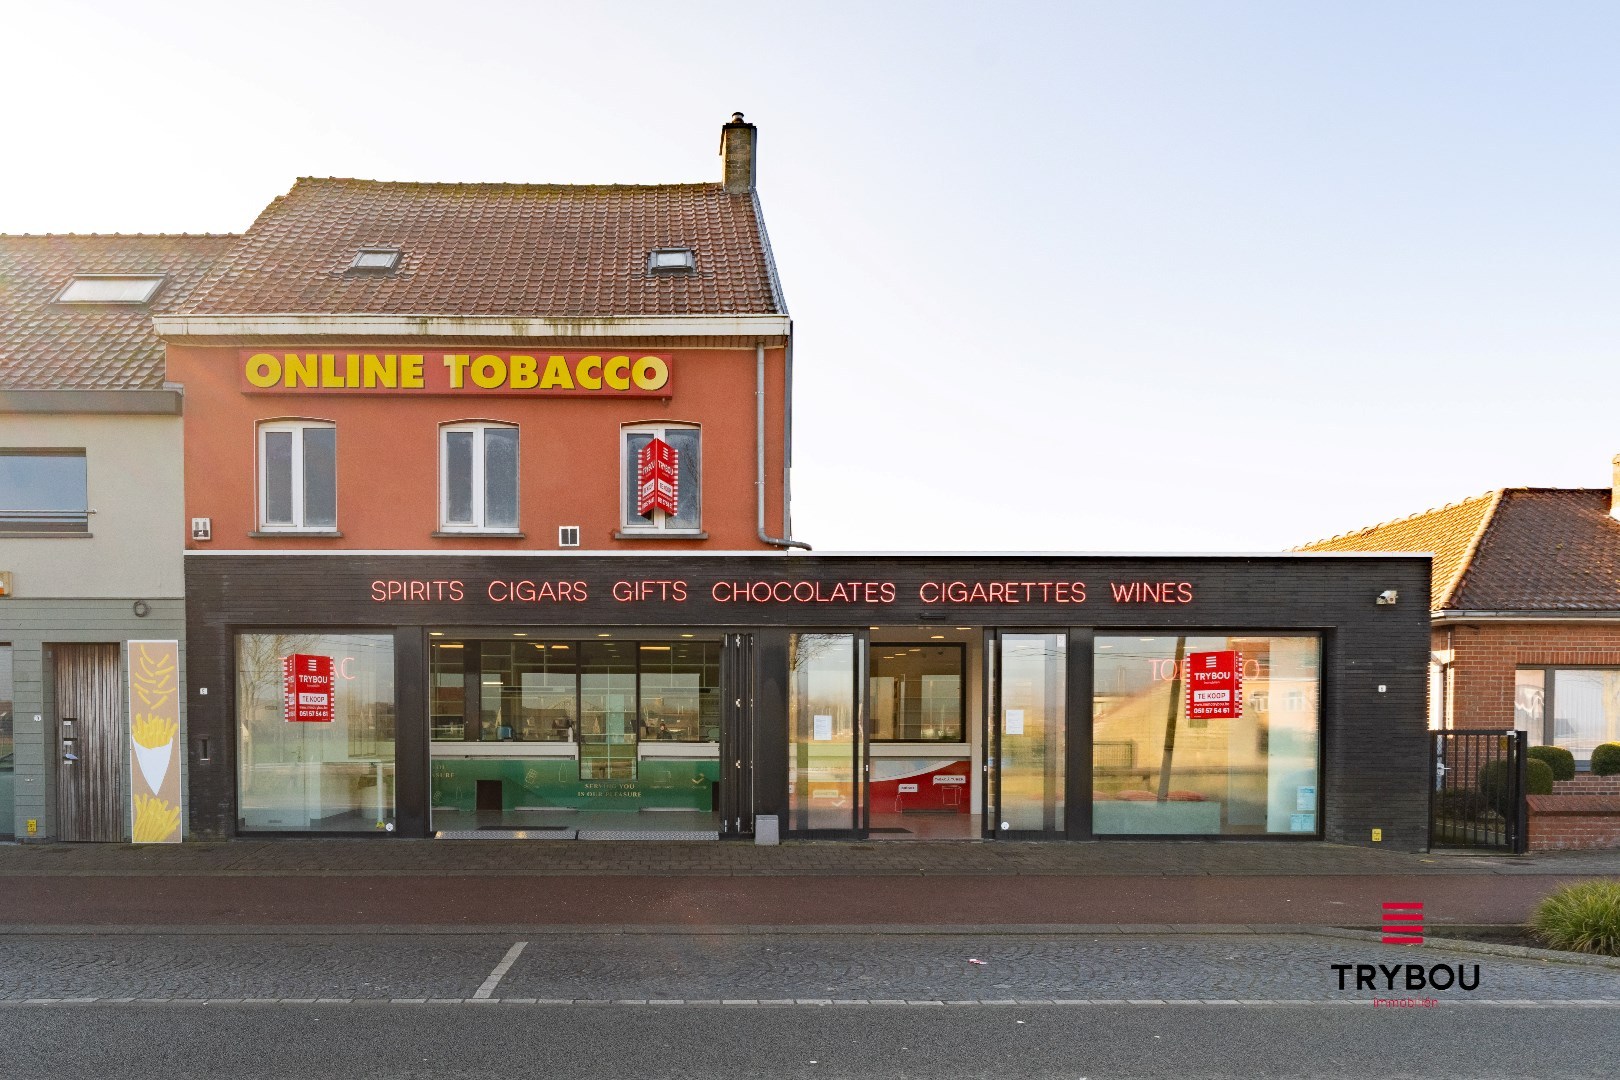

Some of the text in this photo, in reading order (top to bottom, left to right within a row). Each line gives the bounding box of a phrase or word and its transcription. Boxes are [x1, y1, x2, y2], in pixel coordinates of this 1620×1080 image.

[245, 353, 669, 391] ONLINE TOBACCO
[370, 580, 1193, 603] SPIRITS CIGARS GIFTS CHOCOLATES CIGARETTES WINES
[298, 675, 328, 684] TRYBOU
[1193, 672, 1231, 681] TRYBOU
[1207, 692, 1226, 700] KOOP
